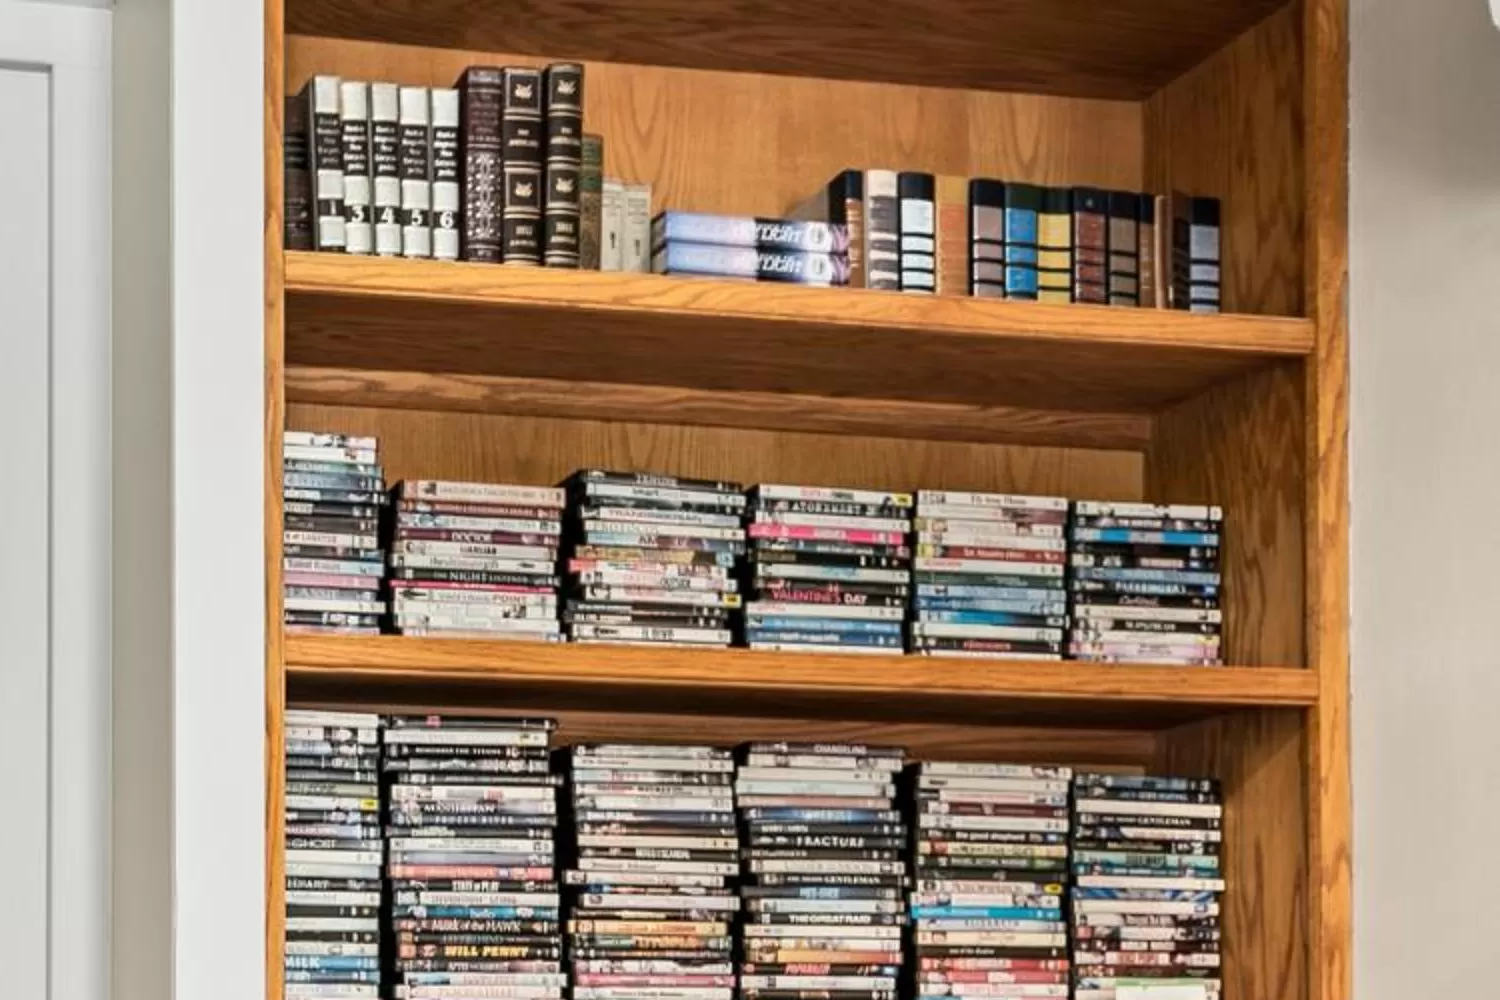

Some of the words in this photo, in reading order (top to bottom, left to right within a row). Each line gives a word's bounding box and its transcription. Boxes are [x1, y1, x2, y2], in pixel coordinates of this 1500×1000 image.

[351, 204, 365, 224] 3
[380, 206, 395, 225] 4
[410, 208, 423, 227] 5
[439, 210, 454, 229] 6
[449, 571, 488, 582] NIGHT
[843, 593, 867, 605] DAY
[796, 835, 865, 848] FRACTURE
[823, 875, 880, 884] GENTLEMAN
[486, 920, 521, 932] HAWK
[444, 945, 478, 956] WILL
[481, 946, 529, 957] PENNY
